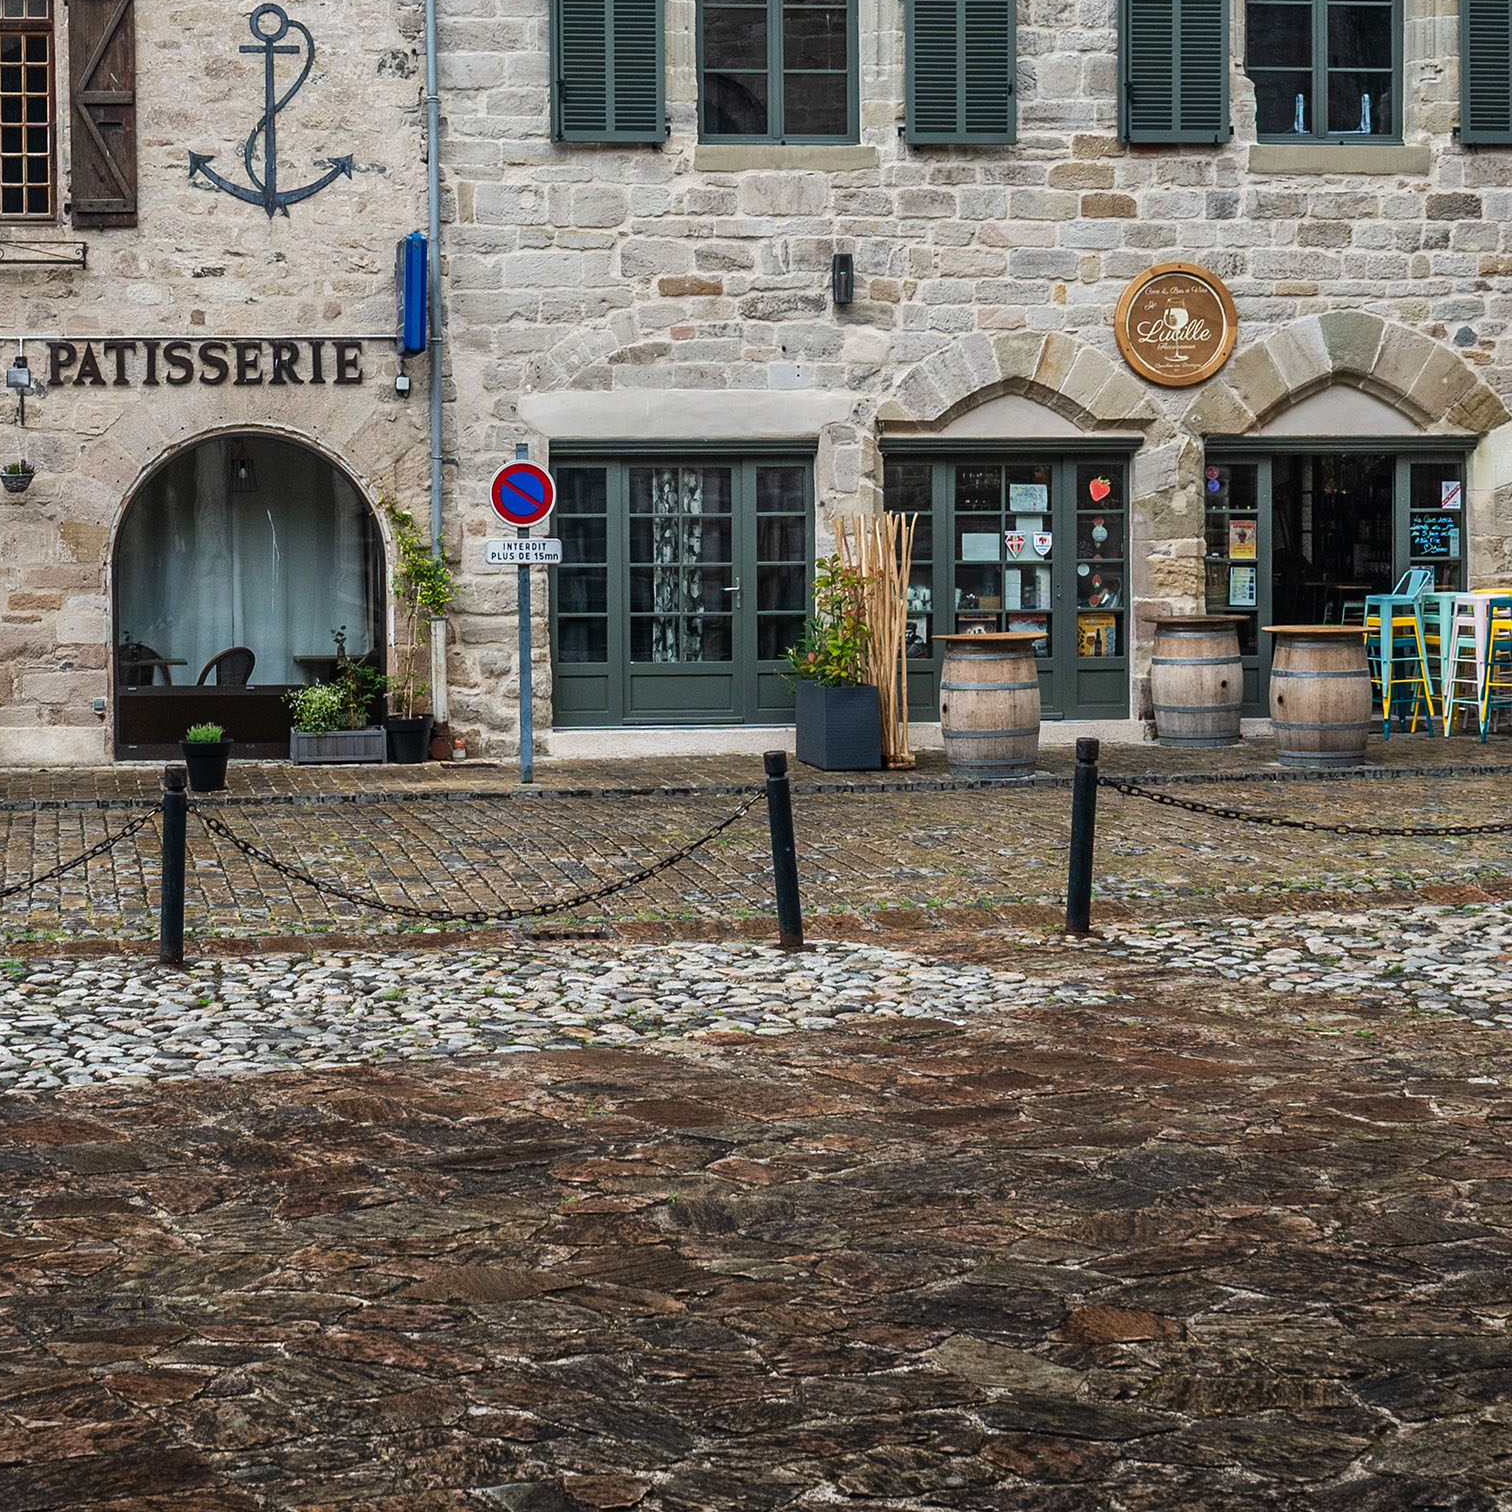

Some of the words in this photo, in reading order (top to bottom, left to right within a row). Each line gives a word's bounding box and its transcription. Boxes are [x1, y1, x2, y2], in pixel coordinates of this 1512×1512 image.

[1170, 286, 1184, 295] Bar
[1137, 319, 1212, 343] Lucille
[48, 340, 363, 386] PATISSERIE
[503, 542, 547, 551] INTERDIT
[491, 552, 515, 560] PLUS
[519, 552, 530, 560] DE
[534, 552, 559, 560] 15mn
